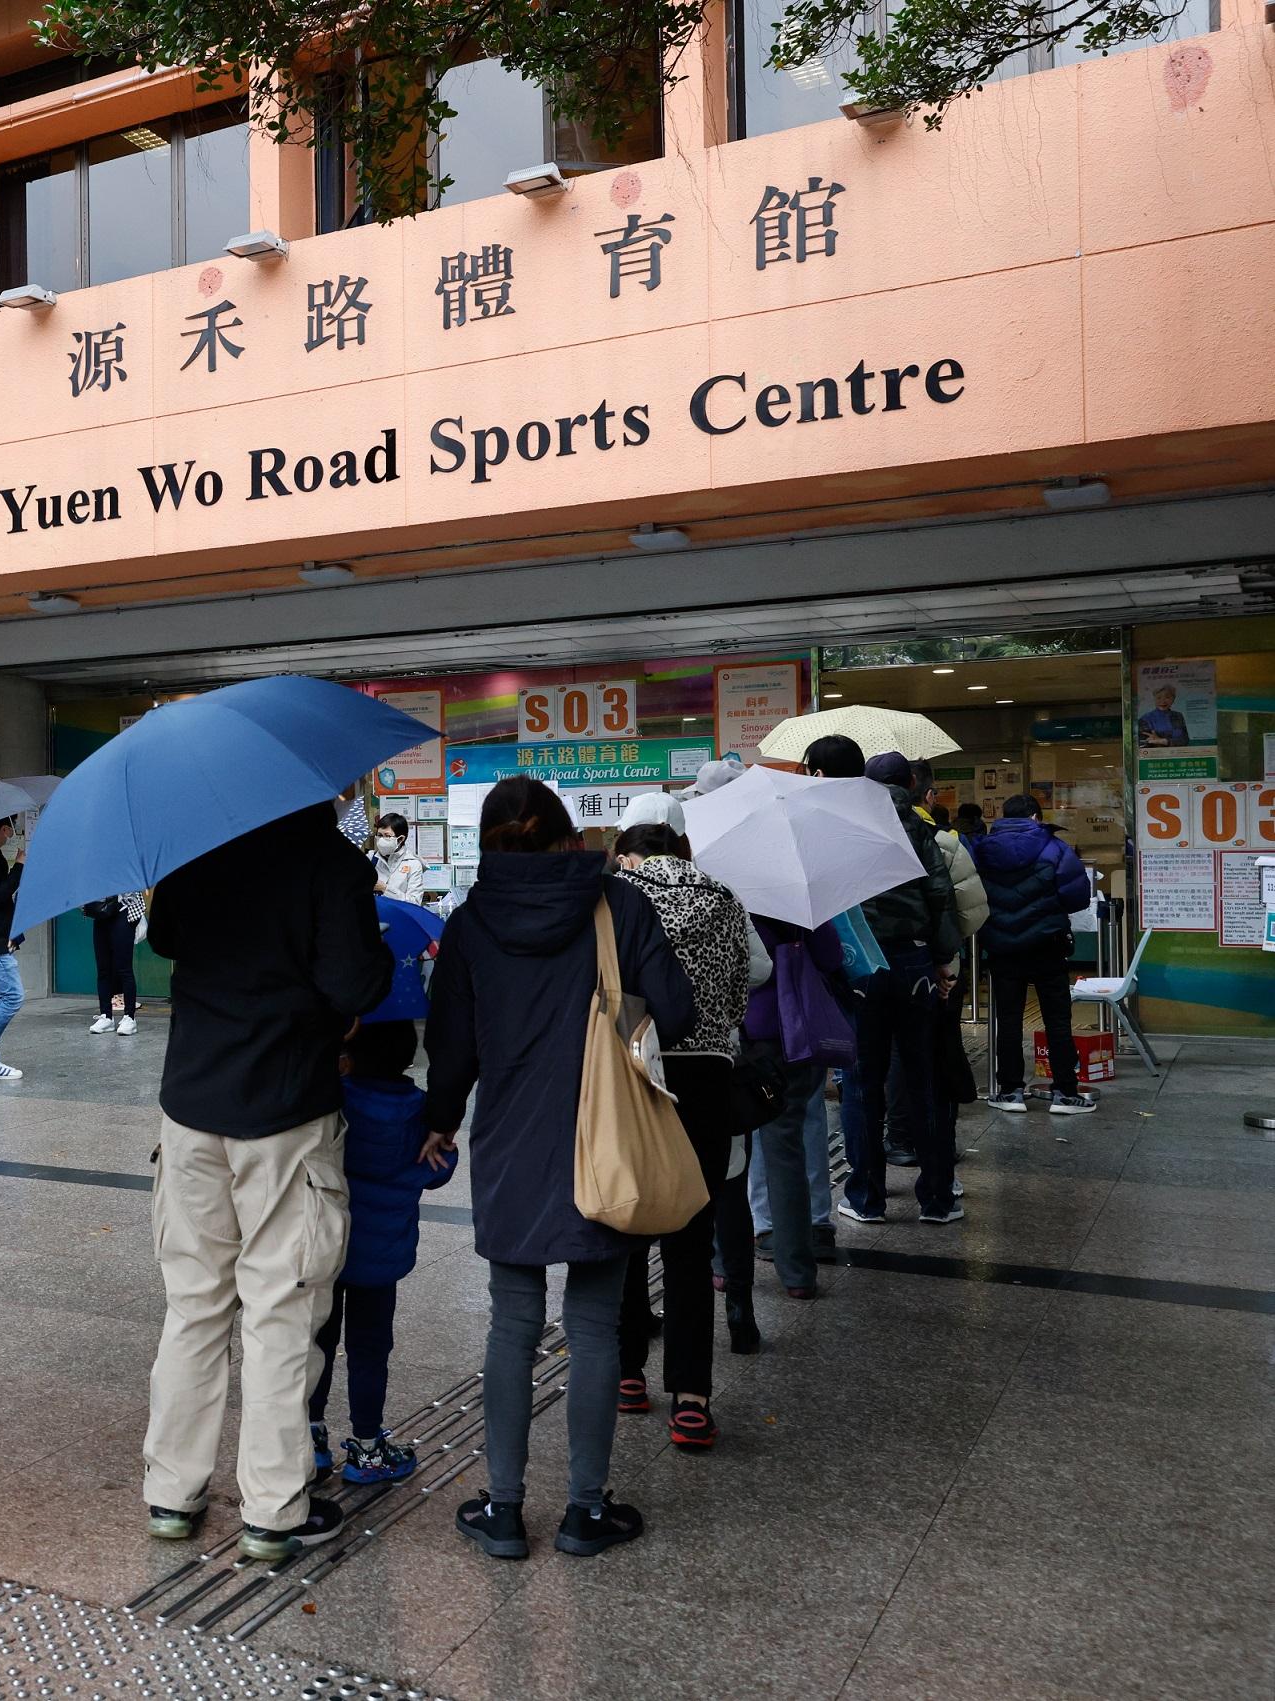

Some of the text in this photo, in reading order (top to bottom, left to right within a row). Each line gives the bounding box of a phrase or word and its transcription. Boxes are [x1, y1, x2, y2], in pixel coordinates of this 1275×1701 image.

[67, 176, 846, 398] 源禾路體育館
[137, 459, 224, 513] Wo
[246, 429, 401, 501] Road
[430, 398, 651, 485] Sports
[689, 358, 965, 436] Centre
[525, 687, 629, 734] S03
[516, 744, 640, 767] 源禾路體育館
[548, 768, 579, 780] Road
[582, 767, 620, 782] Sports
[623, 764, 661, 779] Centre
